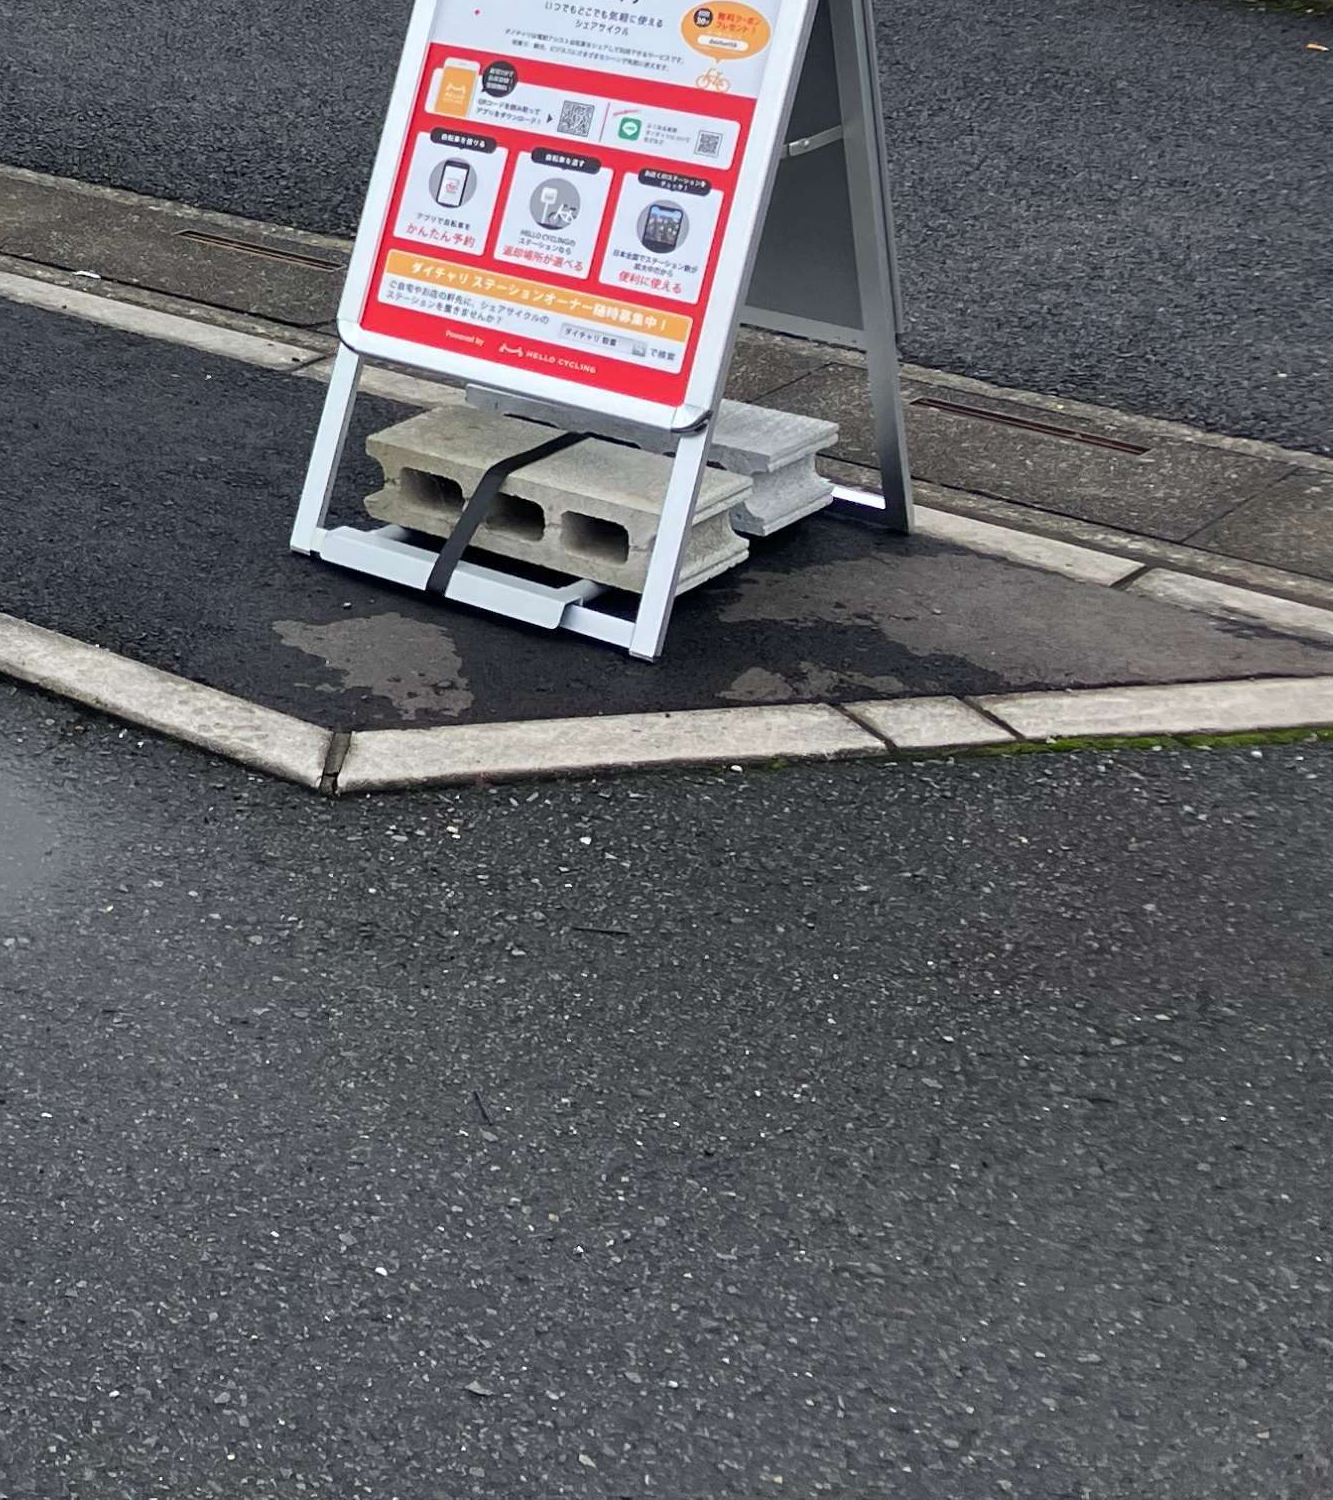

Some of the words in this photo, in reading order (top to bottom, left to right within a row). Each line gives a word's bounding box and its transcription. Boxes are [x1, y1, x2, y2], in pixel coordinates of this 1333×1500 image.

[544, 1, 664, 28] いつでもどこでも気軽に使える
[575, 19, 629, 36] シェアサイクル
[441, 133, 485, 148] 自転車を借りる
[405, 222, 475, 248] かんたん予約
[518, 236, 572, 255] ステーションなら
[502, 244, 584, 272] 返却場所が選べる
[410, 260, 468, 284] ダイチャリ
[618, 270, 682, 295] 便利に使える
[445, 329, 474, 343] Powered
[475, 337, 484, 346] by
[564, 327, 599, 343] ダイチャリ
[526, 350, 555, 363] HELLO
[558, 358, 596, 374] CYCLING
